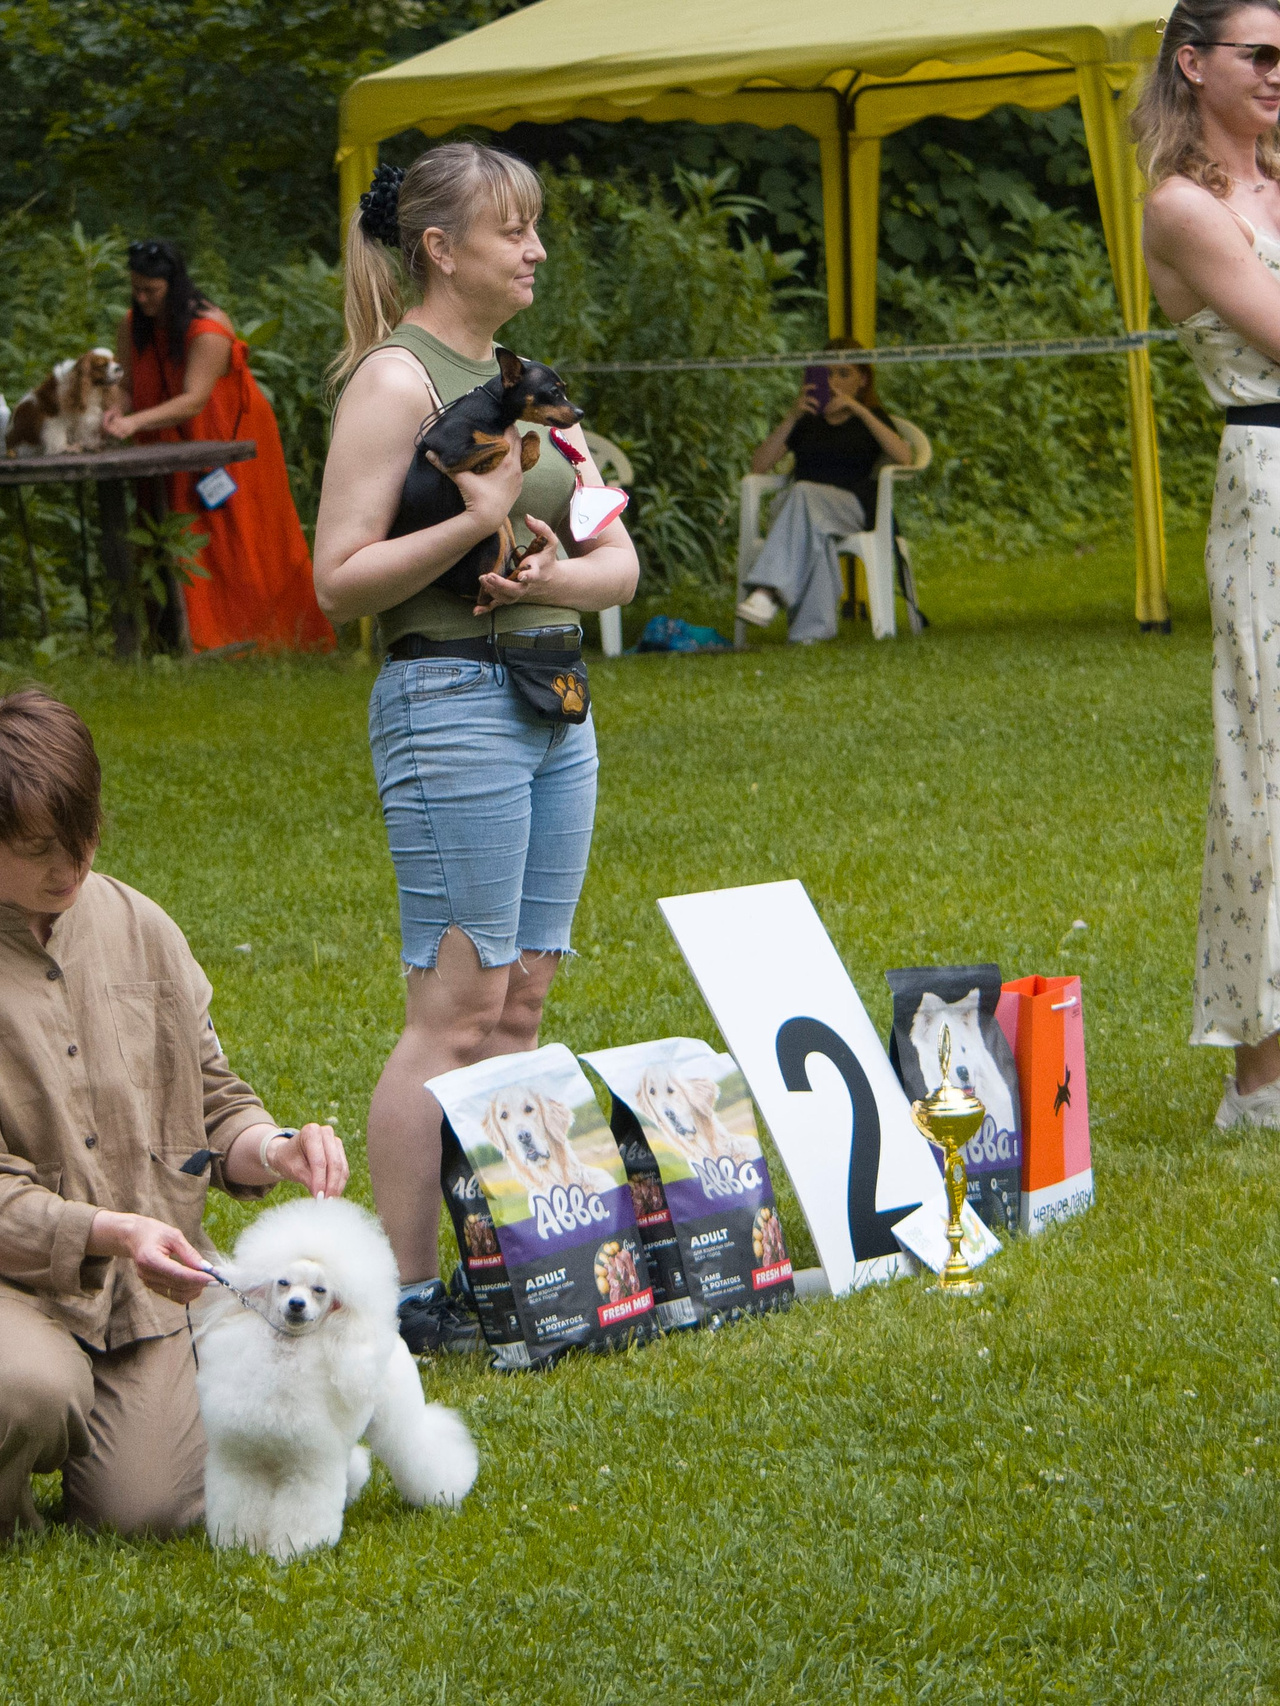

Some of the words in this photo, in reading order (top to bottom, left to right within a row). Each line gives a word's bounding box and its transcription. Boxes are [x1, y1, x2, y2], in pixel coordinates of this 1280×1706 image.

[775, 1015, 923, 1263] 2
[1033, 1197, 1069, 1222] четыре
[691, 1228, 728, 1249] ADULT
[525, 1268, 566, 1291] ADULT
[700, 1272, 720, 1283] LAMB
[710, 1274, 741, 1289] POTATOES
[756, 1266, 780, 1284] FRESH
[535, 1314, 558, 1327] LAMB
[603, 1301, 632, 1321] FRESH
[545, 1314, 583, 1332] POTATOES
